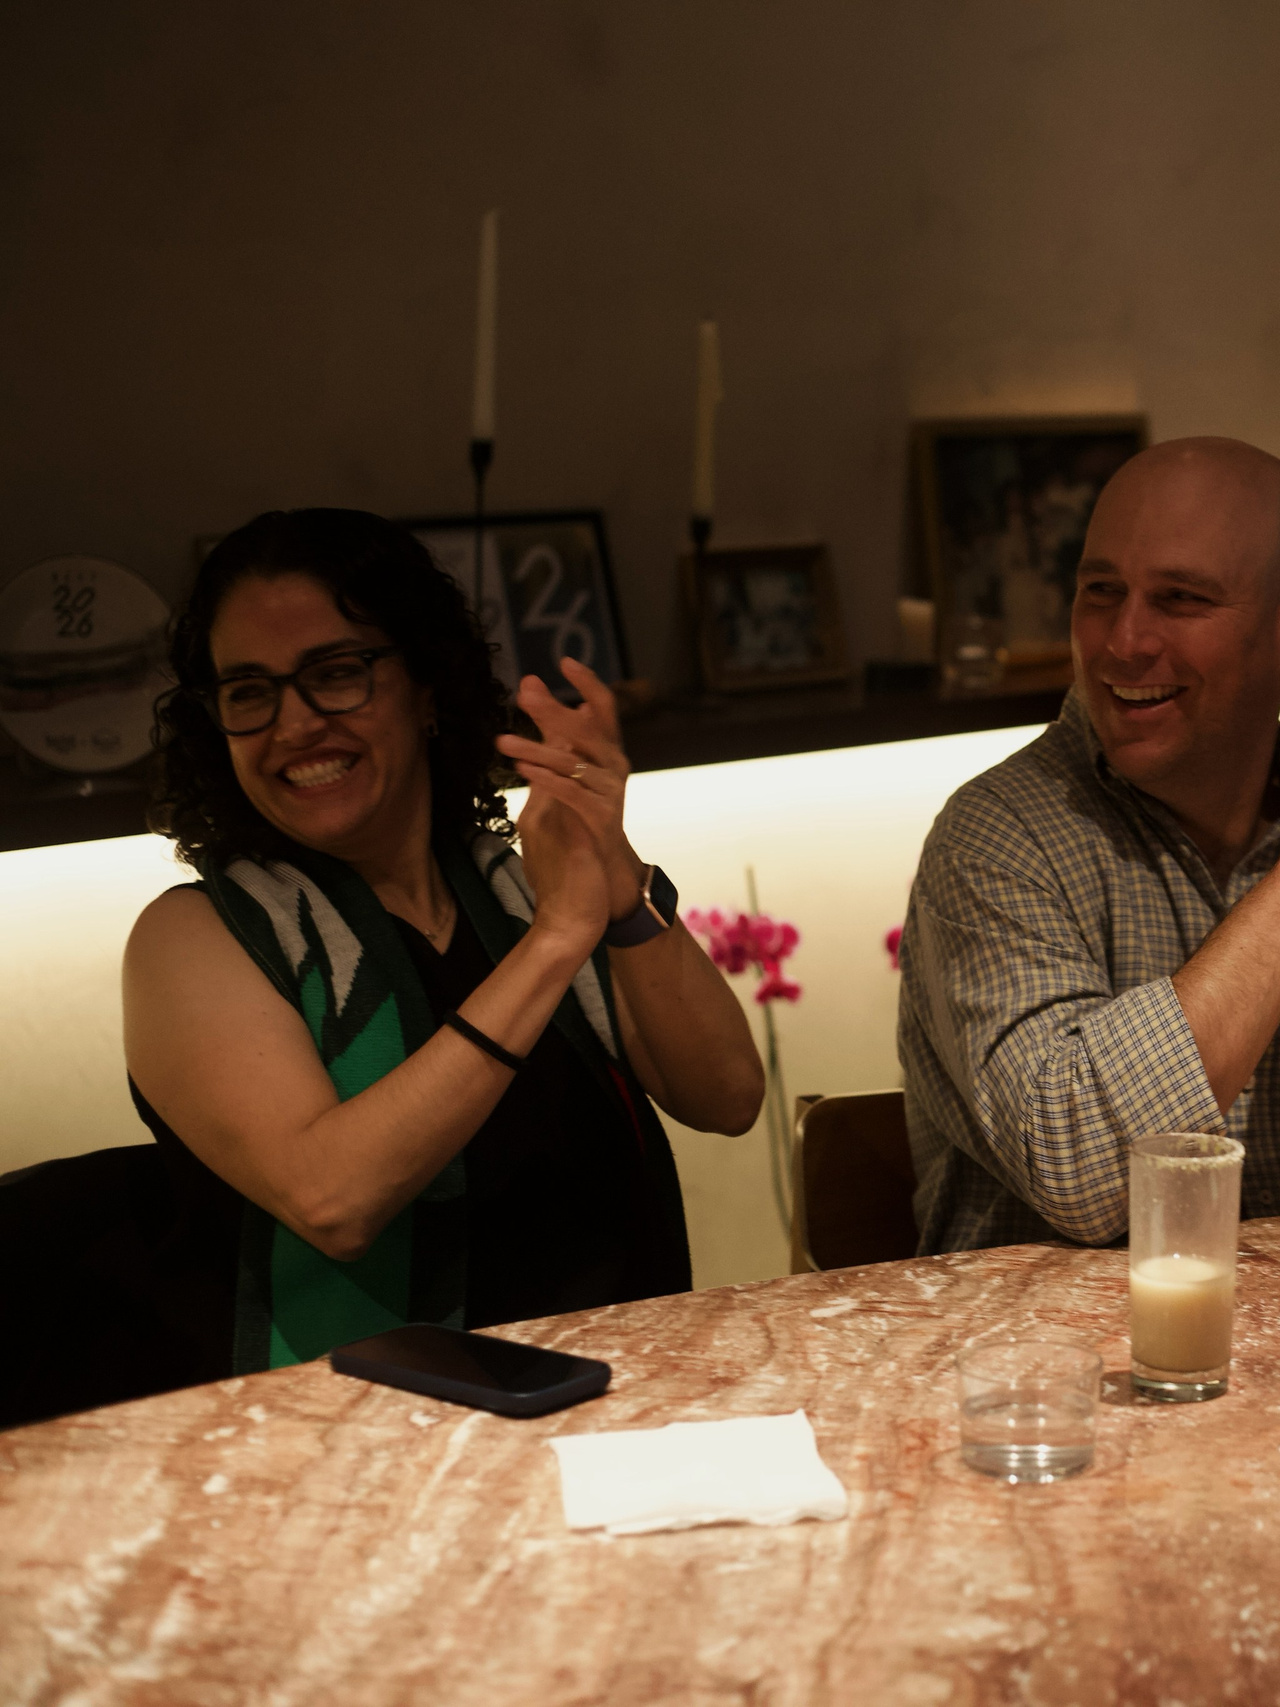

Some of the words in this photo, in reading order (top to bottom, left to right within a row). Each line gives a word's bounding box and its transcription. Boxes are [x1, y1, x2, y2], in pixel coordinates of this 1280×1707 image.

[53, 584, 96, 613] 20
[513, 544, 595, 671] 26
[56, 609, 94, 639] 26
